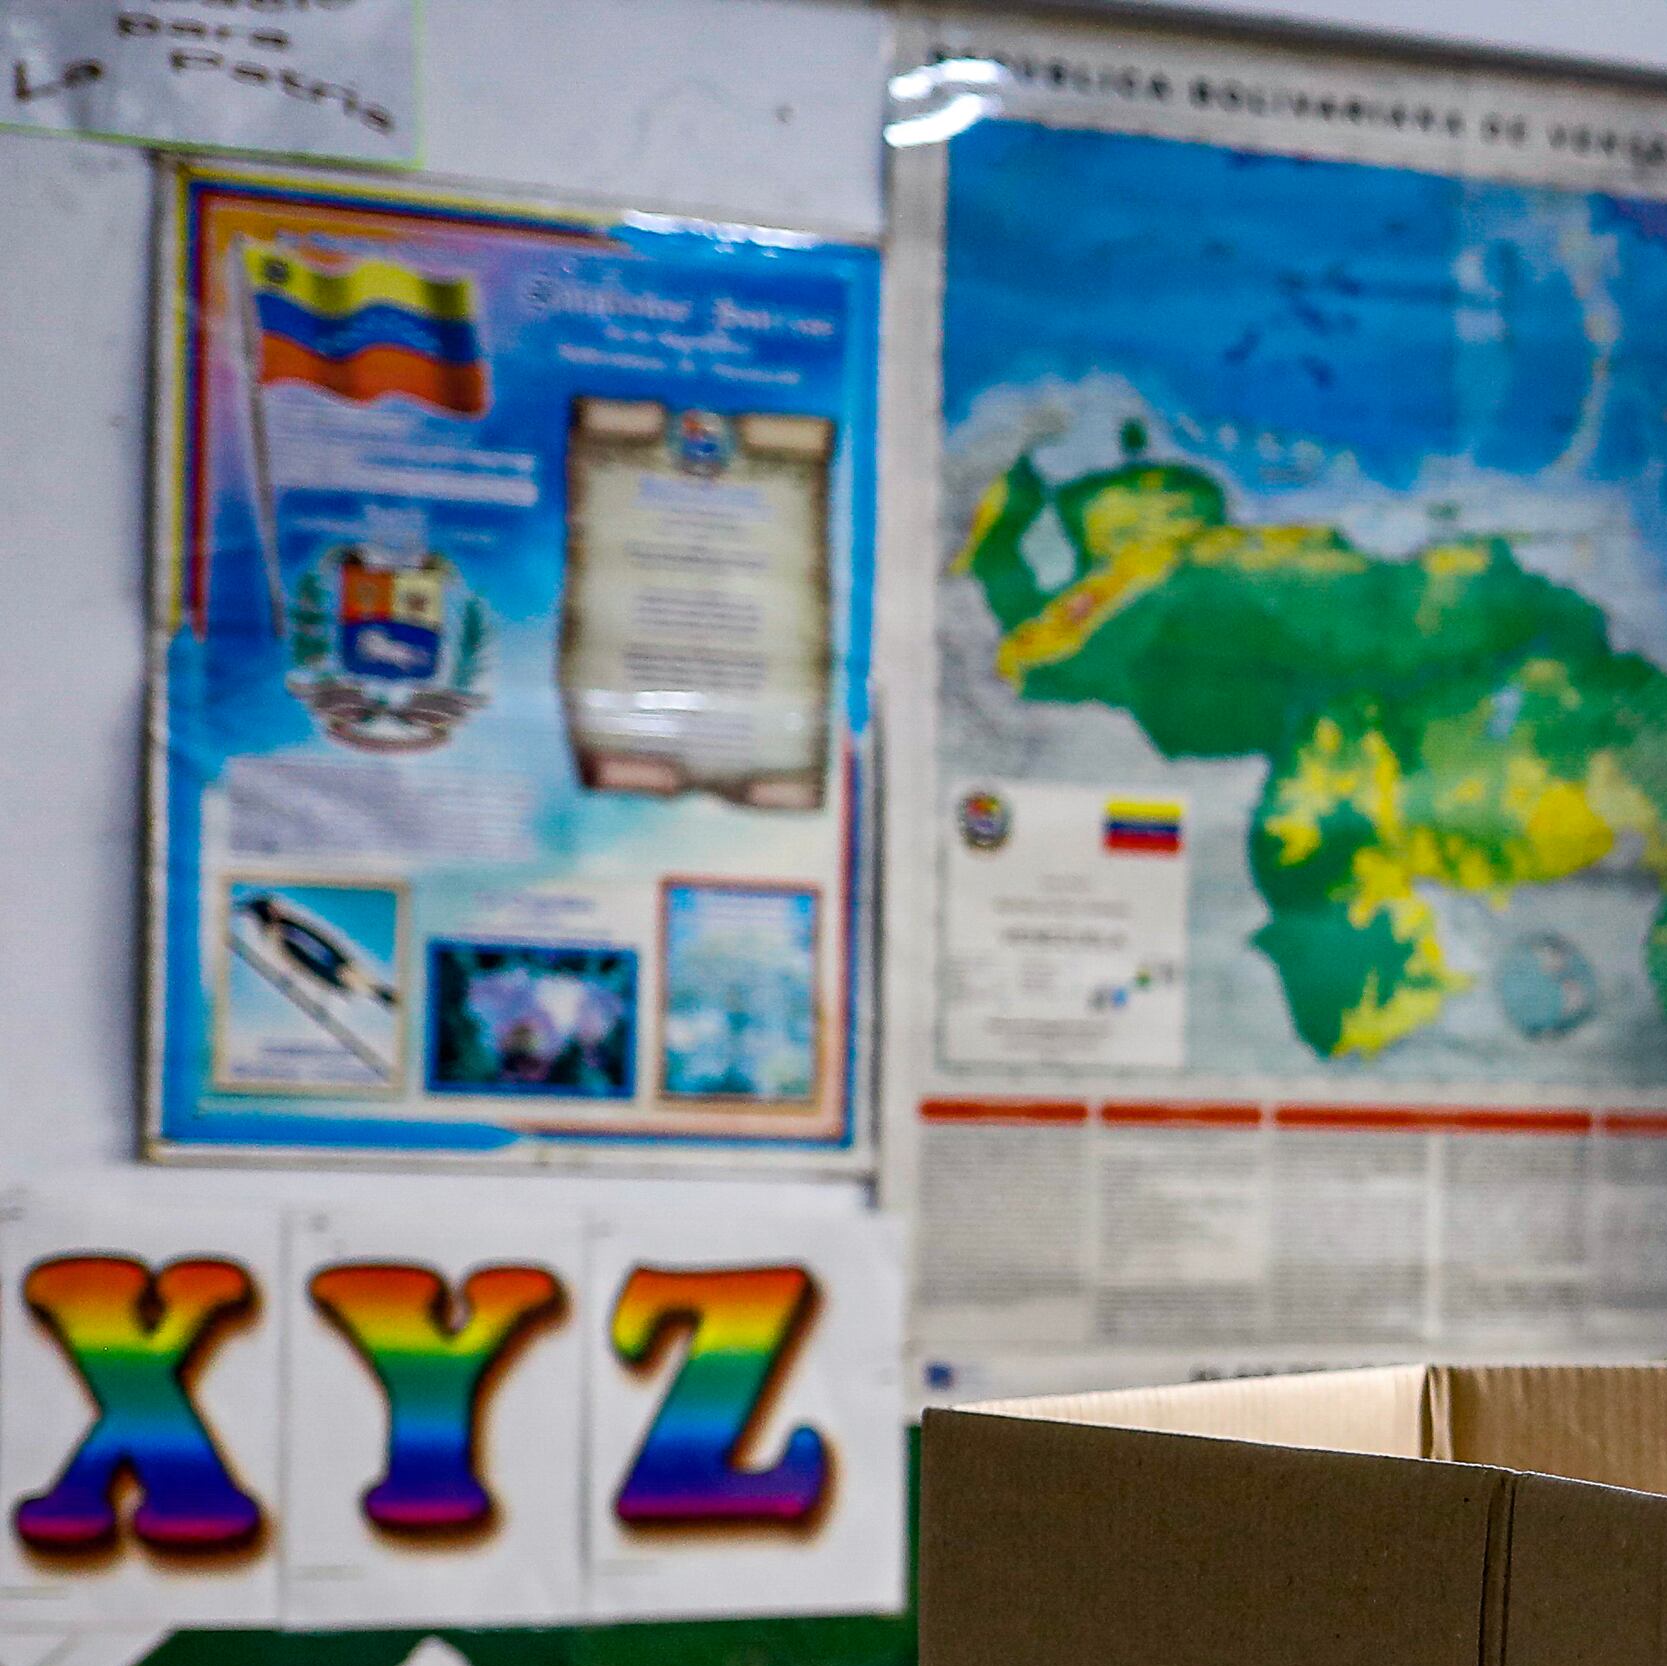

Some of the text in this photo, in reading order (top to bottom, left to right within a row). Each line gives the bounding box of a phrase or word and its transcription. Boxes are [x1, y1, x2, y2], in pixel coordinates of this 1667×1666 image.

[15, 1252, 836, 1558] X Y Z
